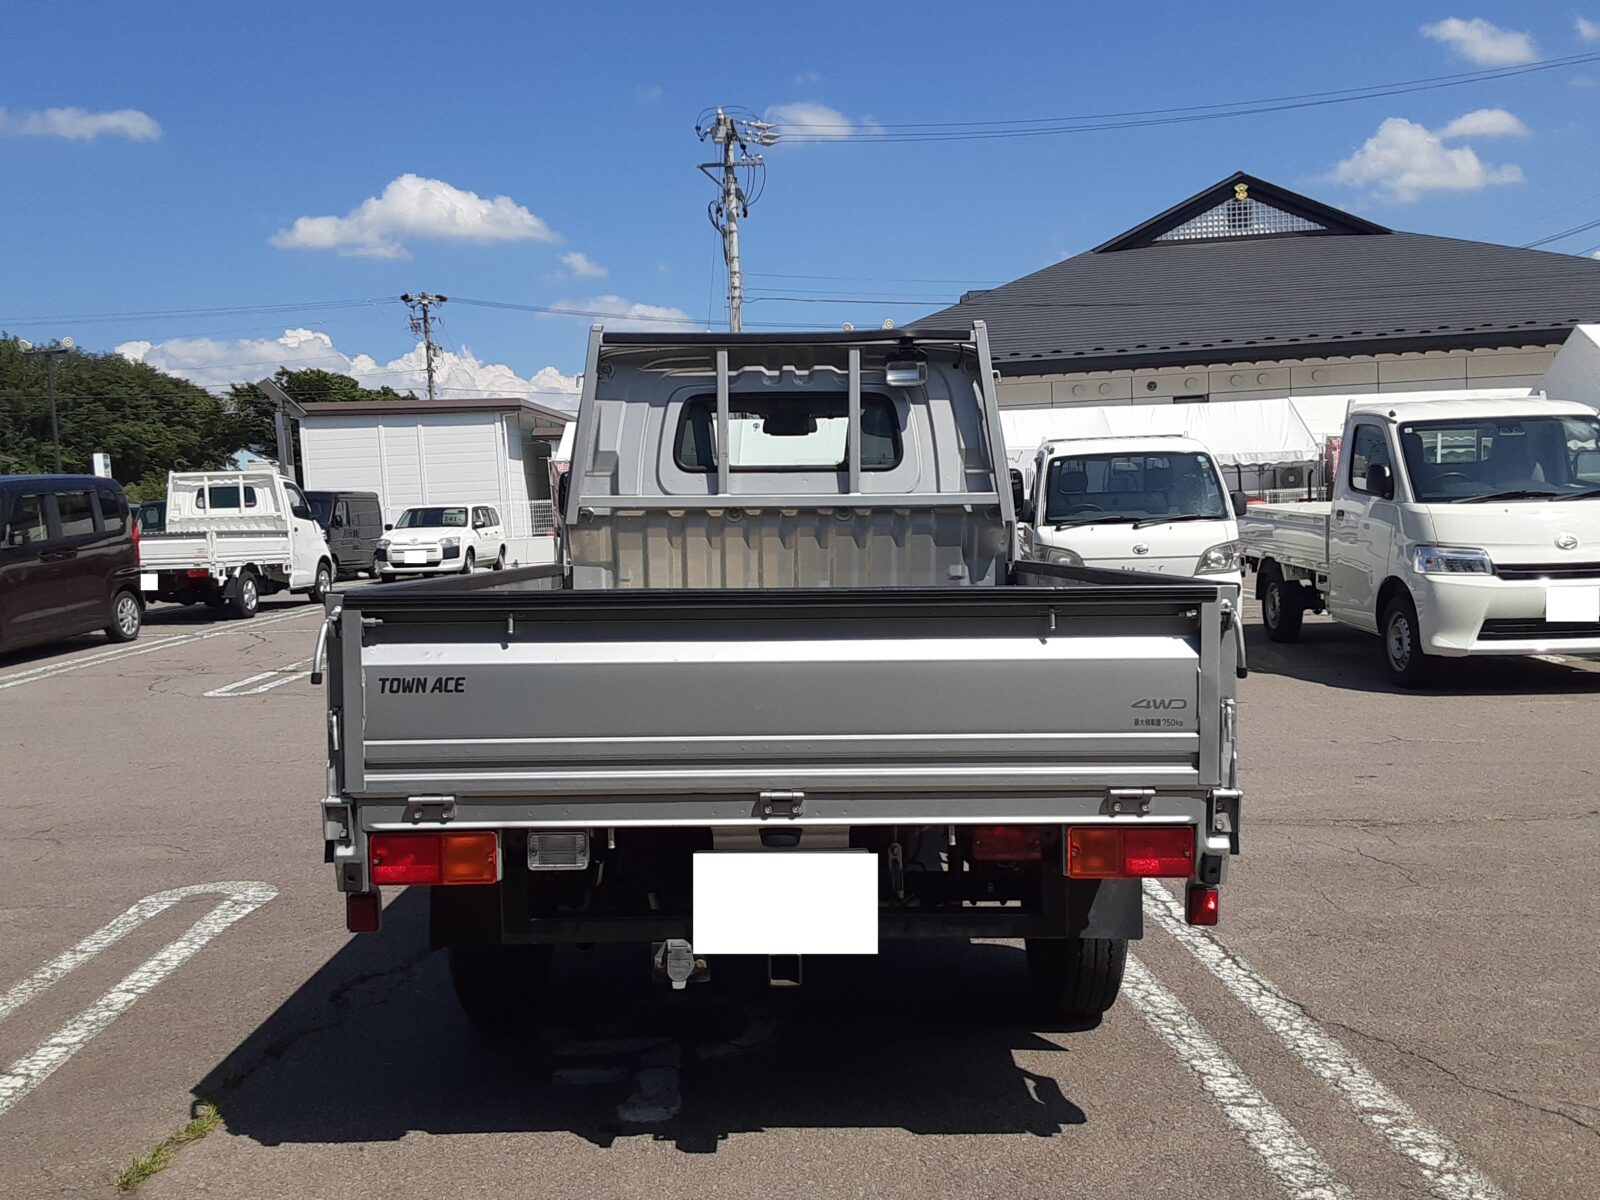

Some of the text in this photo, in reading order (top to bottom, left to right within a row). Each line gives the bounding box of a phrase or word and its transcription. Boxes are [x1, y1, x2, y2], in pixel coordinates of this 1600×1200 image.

[378, 677, 466, 694] TOWN ACE
[1131, 698, 1187, 709] 4WD
